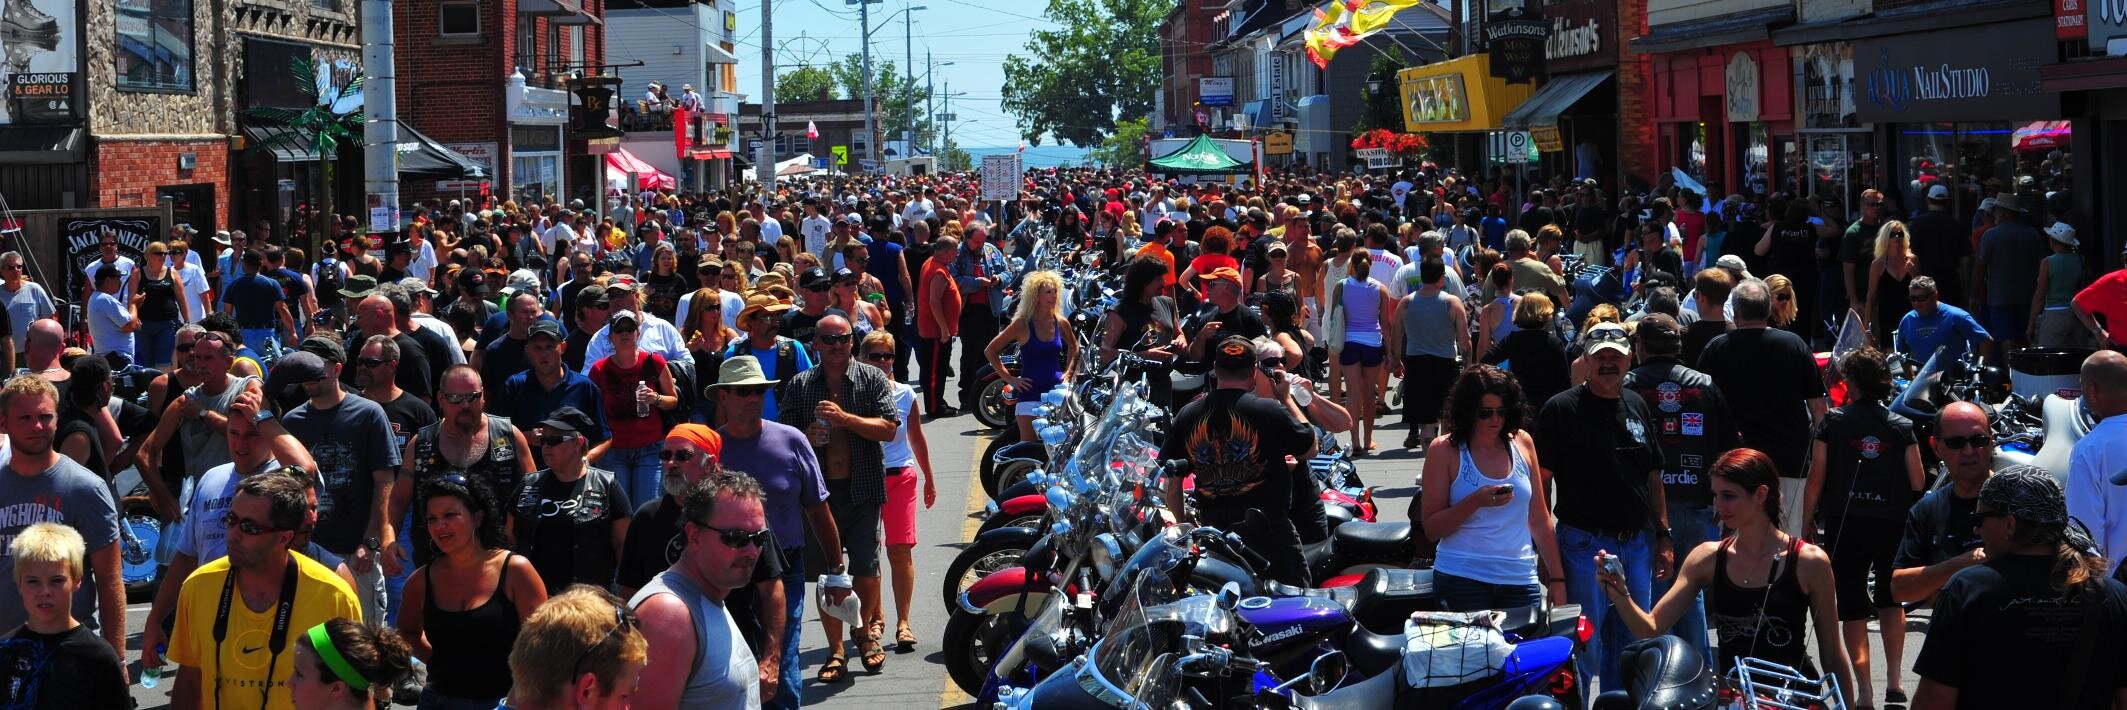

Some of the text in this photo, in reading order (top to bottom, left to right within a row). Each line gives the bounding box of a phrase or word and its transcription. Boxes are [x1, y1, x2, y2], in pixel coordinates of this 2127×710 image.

[1486, 22, 1547, 40] Watkinsons
[1545, 16, 1600, 60] atkinson's
[15, 85, 69, 95] & GEAR LO
[17, 74, 69, 84] GLORIOUS
[1273, 57, 1282, 116] Real Estate
[1867, 65, 1910, 110] AQUA
[1358, 149, 1388, 157] WASHR
[1369, 158, 1382, 167] FOOD
[68, 229, 99, 254] JACK
[277, 601, 290, 631] Canon
[1247, 623, 1303, 648] Kawasaki
